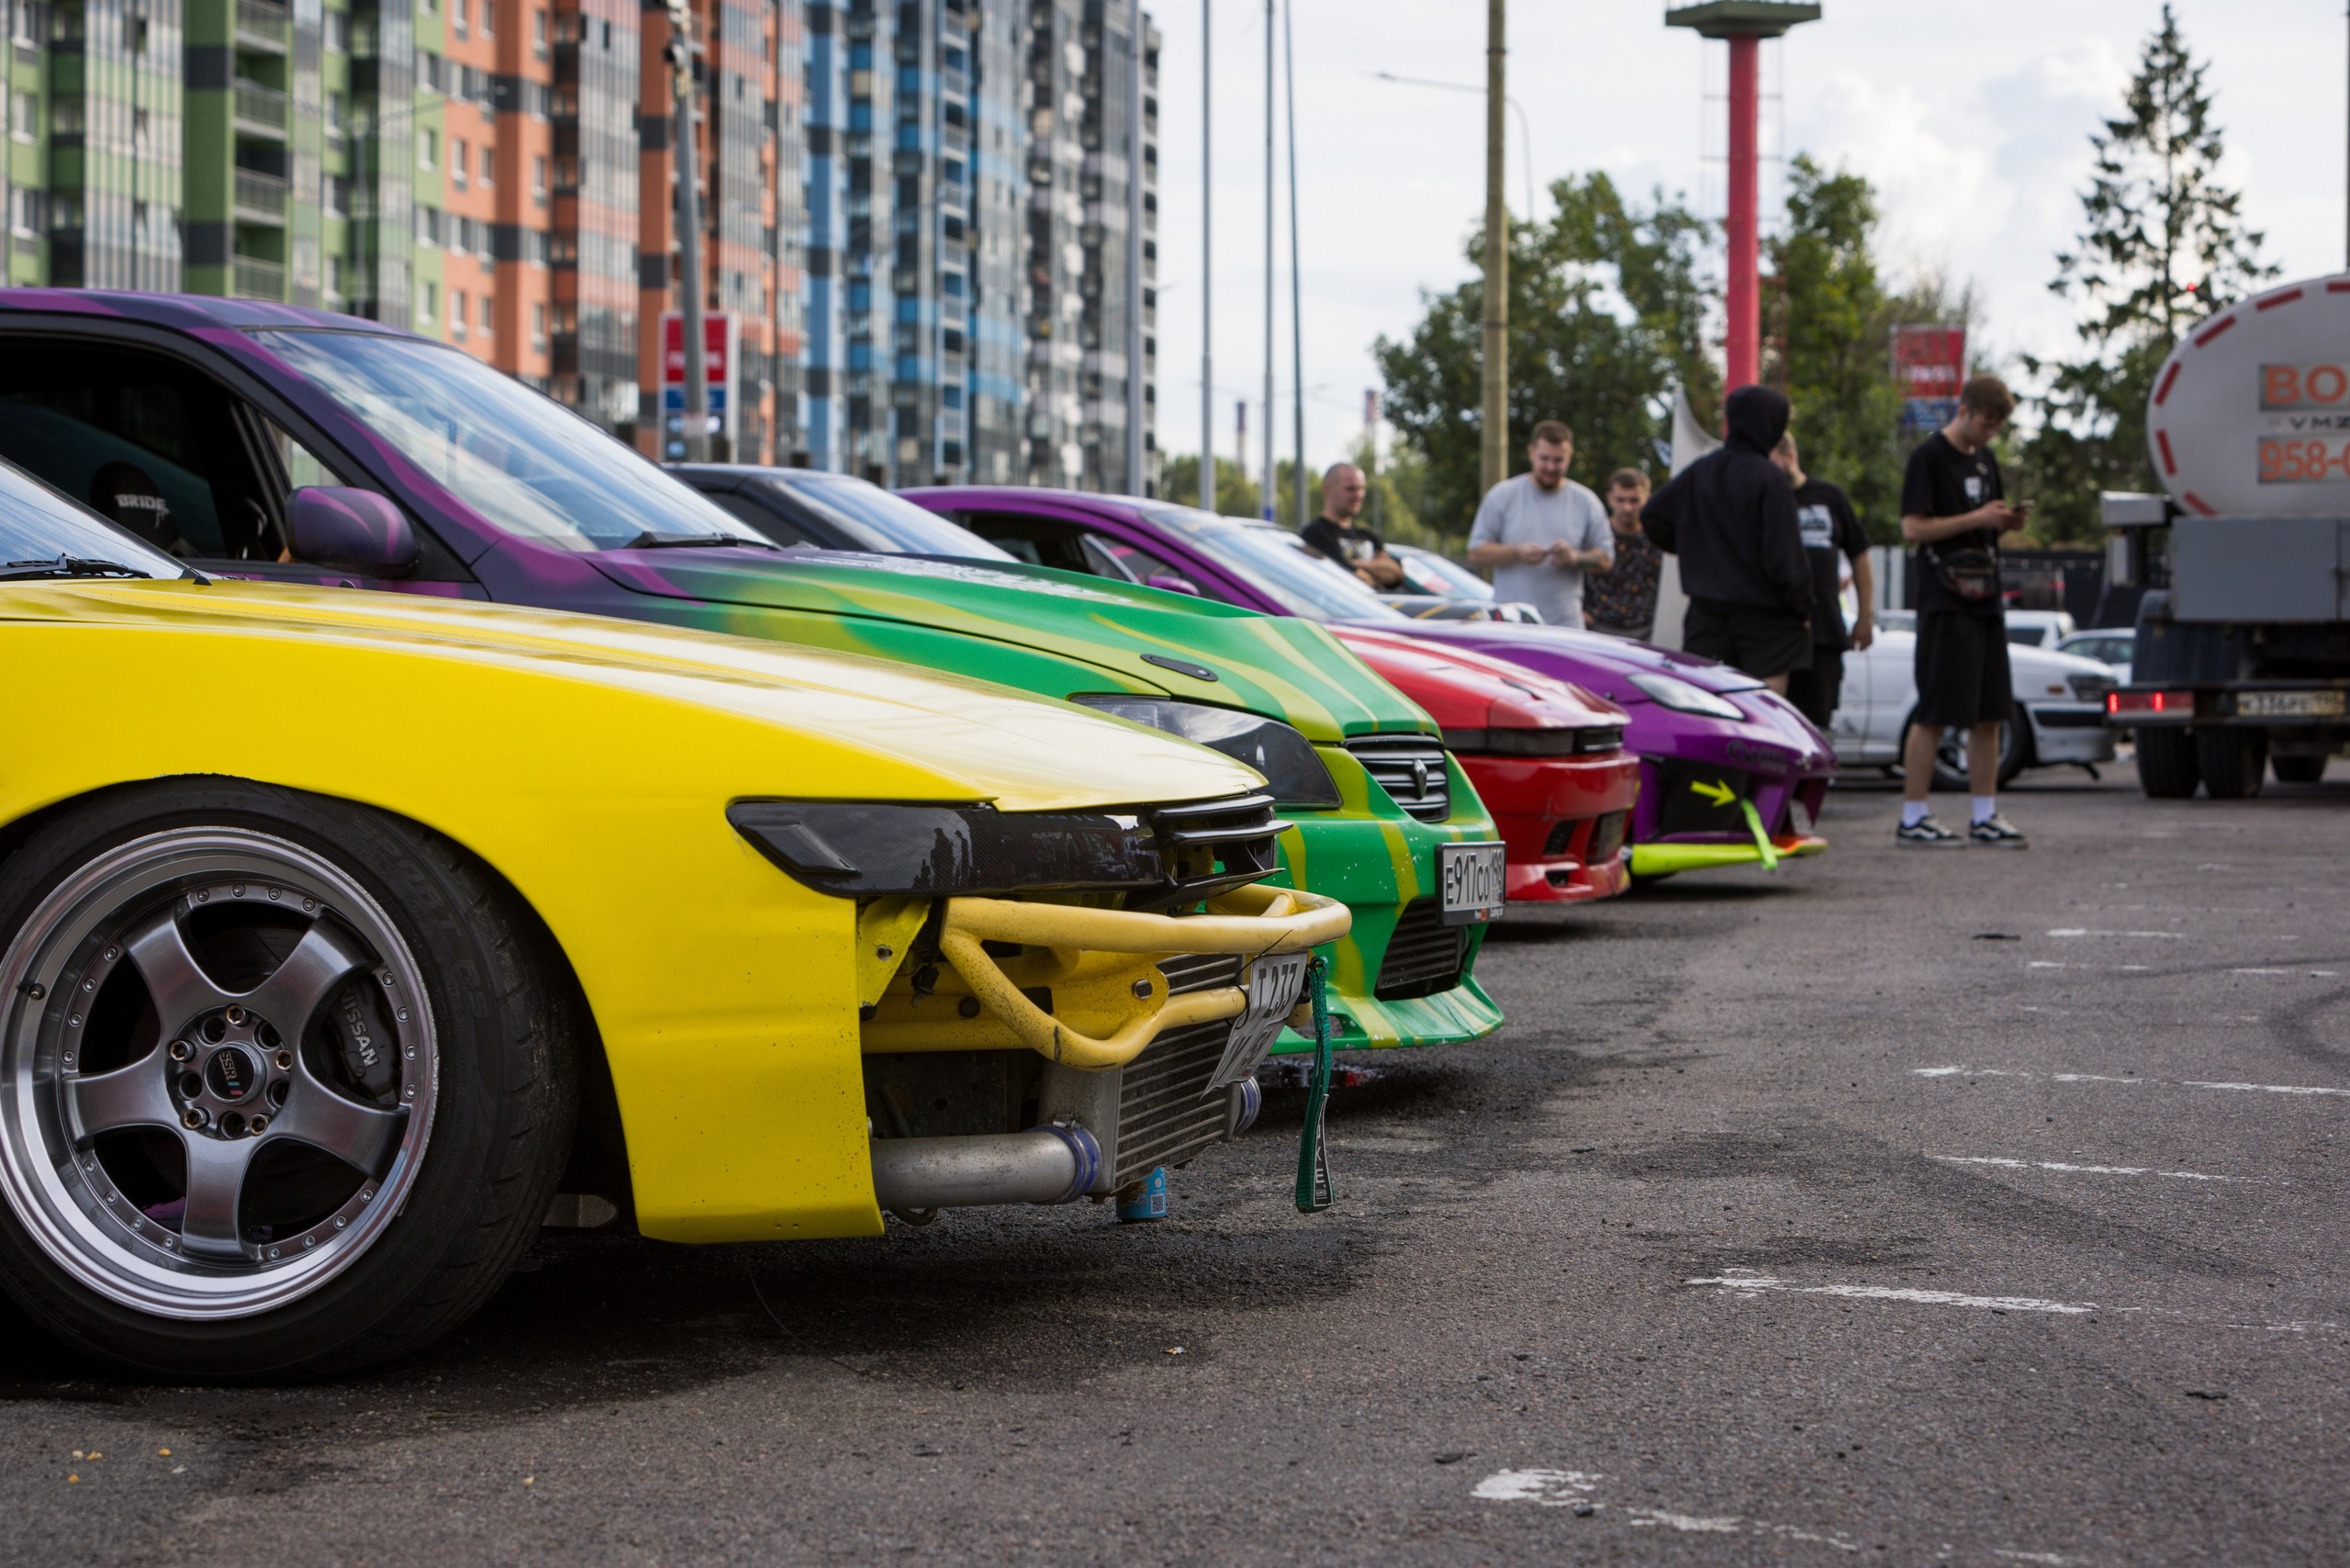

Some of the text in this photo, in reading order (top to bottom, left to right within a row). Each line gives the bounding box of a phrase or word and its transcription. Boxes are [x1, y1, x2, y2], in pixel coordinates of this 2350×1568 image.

[2266, 364, 2350, 404] ВО
[351, 819, 463, 937] SPORT
[1446, 849, 1502, 905] E917CO 198
[340, 986, 379, 1066] NISSAN
[218, 1050, 238, 1081] SSR
